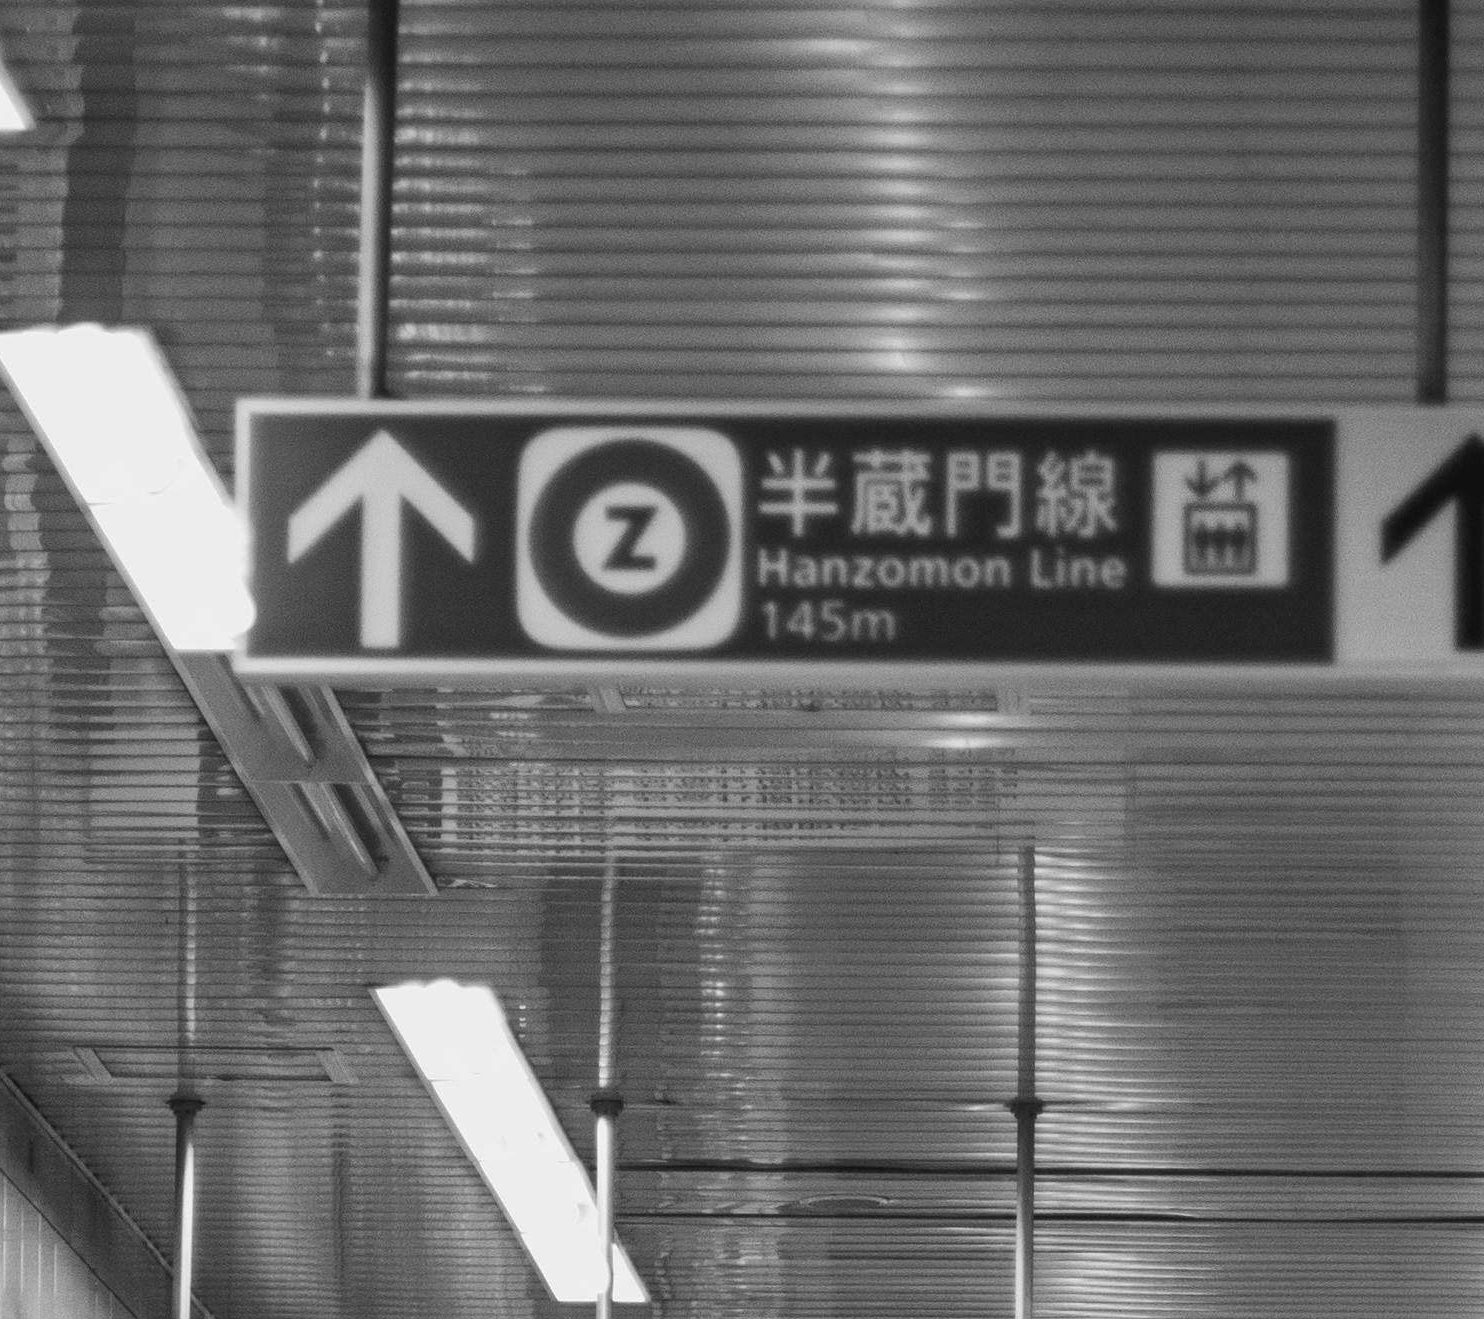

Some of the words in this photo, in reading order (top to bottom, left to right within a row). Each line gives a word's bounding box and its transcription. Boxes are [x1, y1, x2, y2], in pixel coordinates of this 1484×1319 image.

[758, 447, 1119, 537] 半蔵門線
[600, 505, 659, 572] Z
[757, 549, 1012, 588] Hanzomon
[1029, 550, 1127, 588] Line
[760, 602, 897, 642] 145m
